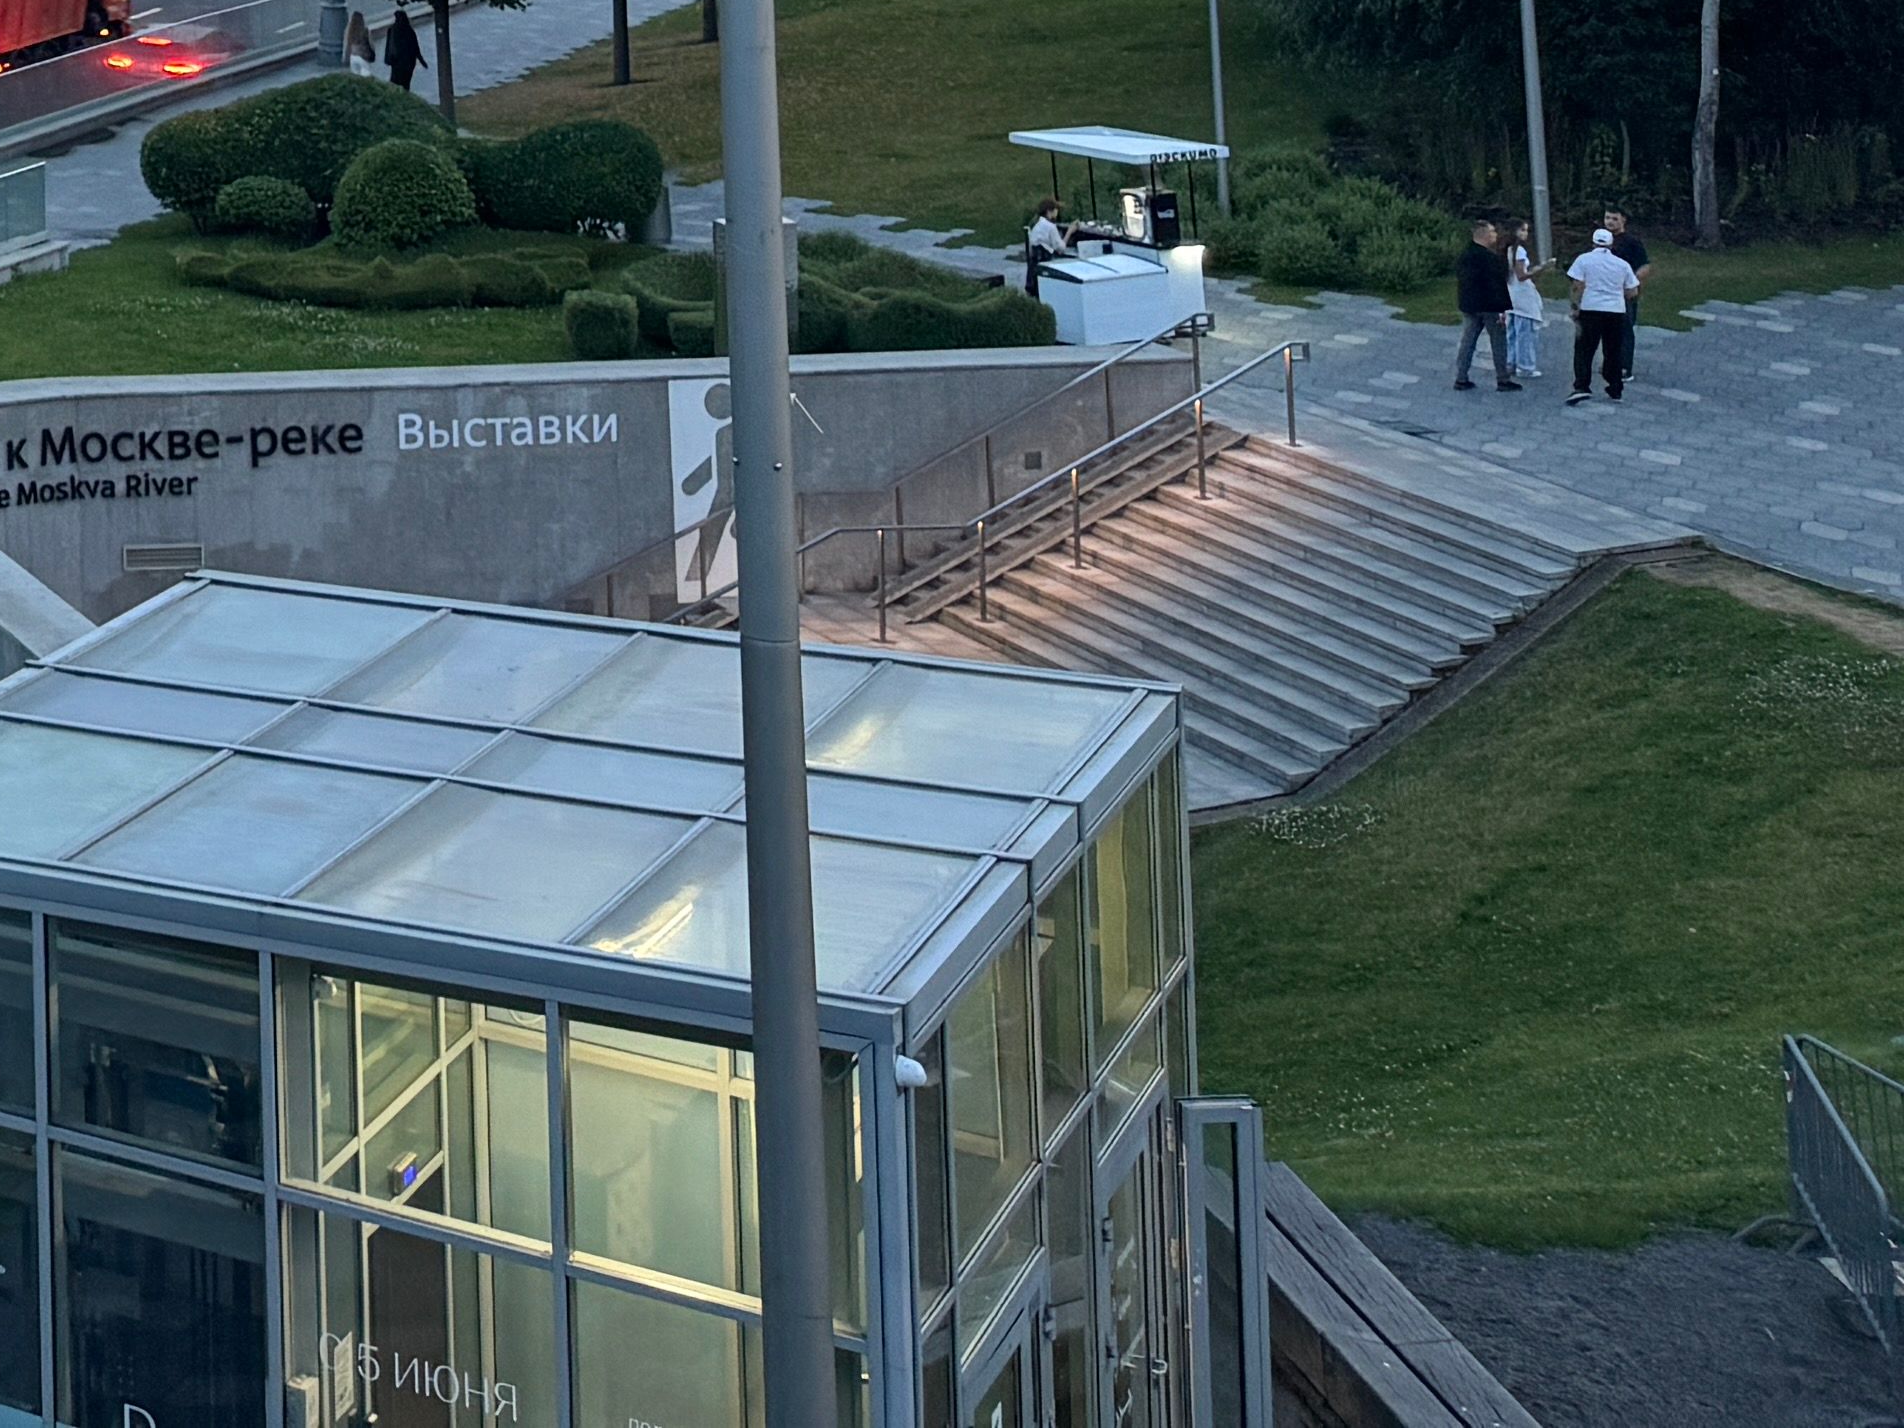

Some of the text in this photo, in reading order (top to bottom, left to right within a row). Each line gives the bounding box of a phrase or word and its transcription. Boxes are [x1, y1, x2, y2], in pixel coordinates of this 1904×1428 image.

[6, 437, 29, 471] к
[40, 421, 365, 468] Москве-реке
[397, 412, 619, 451] Выставки
[16, 474, 116, 507] Moskva
[125, 472, 199, 499] River
[394, 1351, 518, 1423] ИЮНЯ
